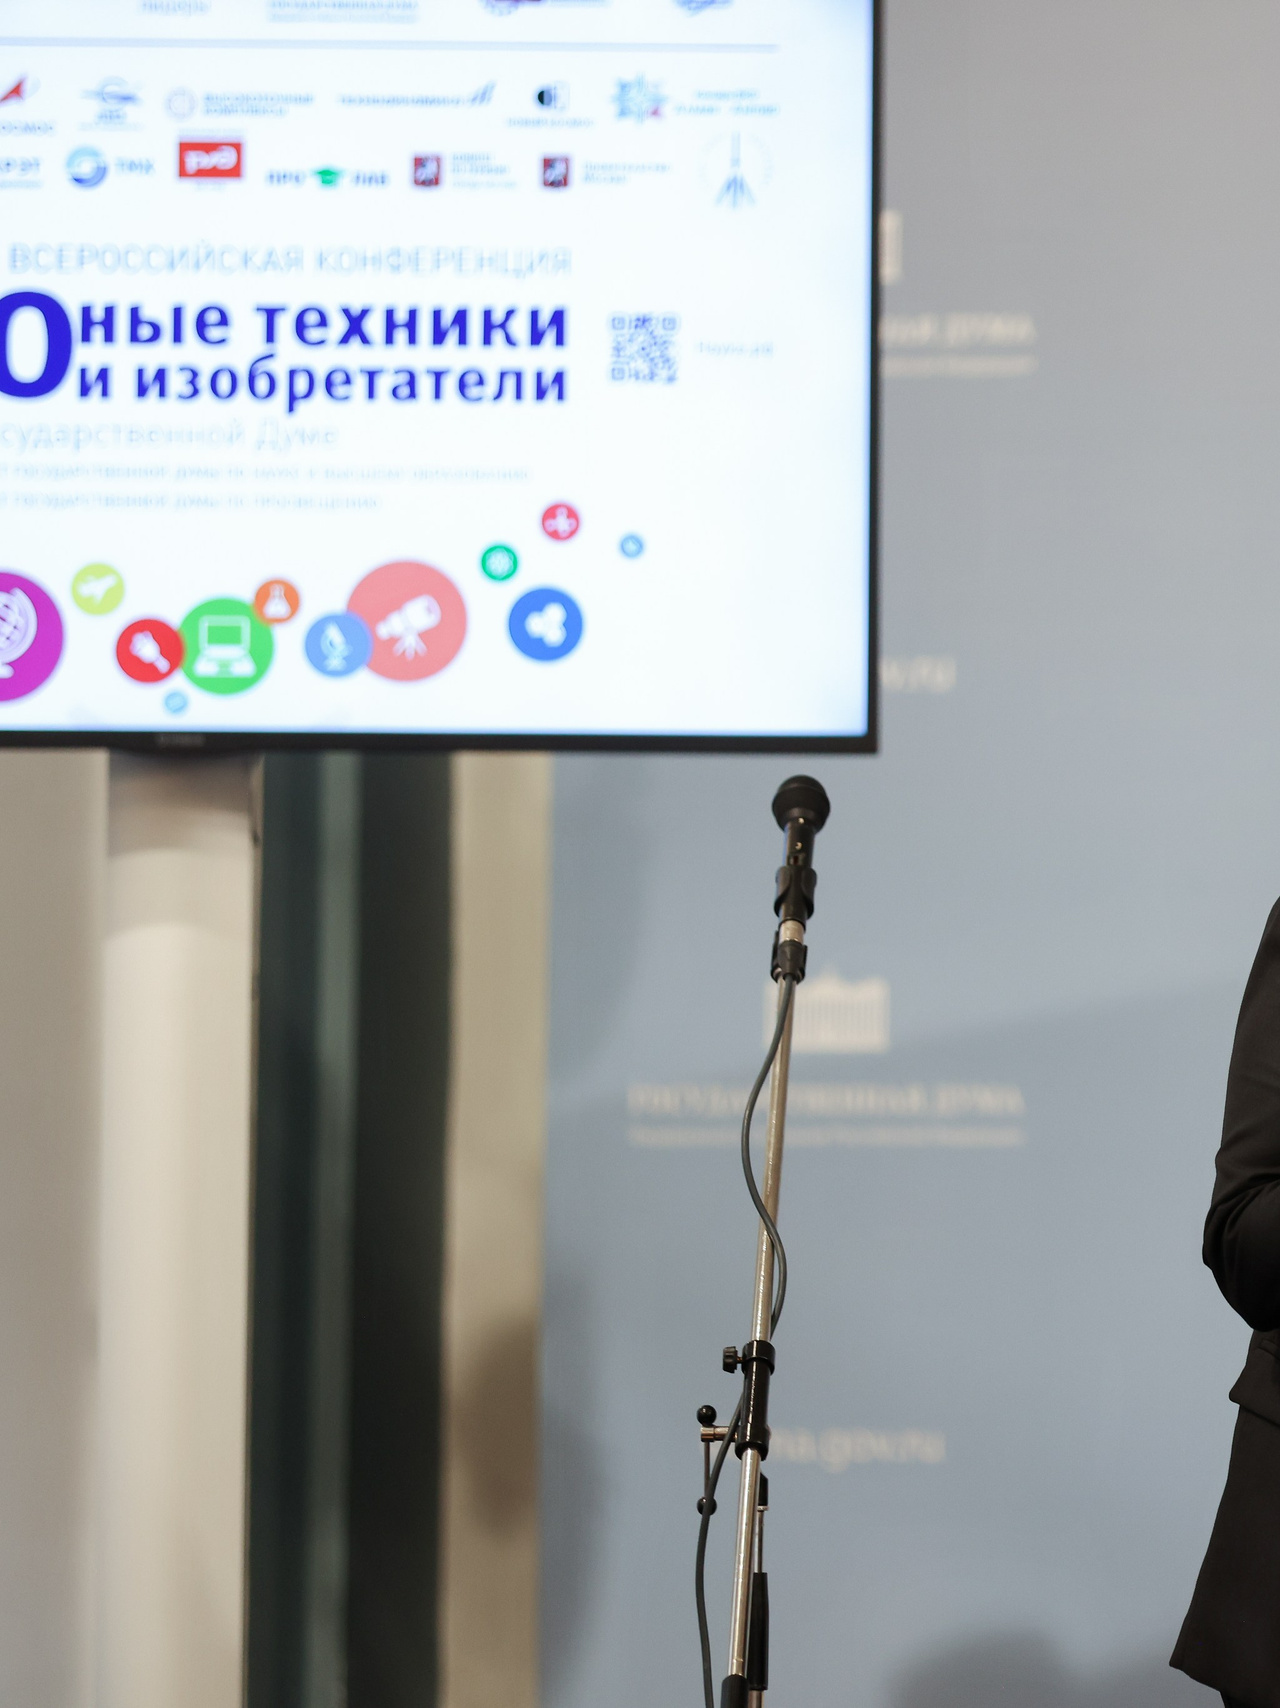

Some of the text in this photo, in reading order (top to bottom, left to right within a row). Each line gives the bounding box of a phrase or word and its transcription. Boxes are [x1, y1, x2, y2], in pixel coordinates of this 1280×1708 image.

[7, 239, 573, 278] ВСЕРОССИЙСКАЯ КОНФЕРЕНЦИЯ
[255, 302, 569, 348] техники
[78, 351, 569, 414] и изобретатели
